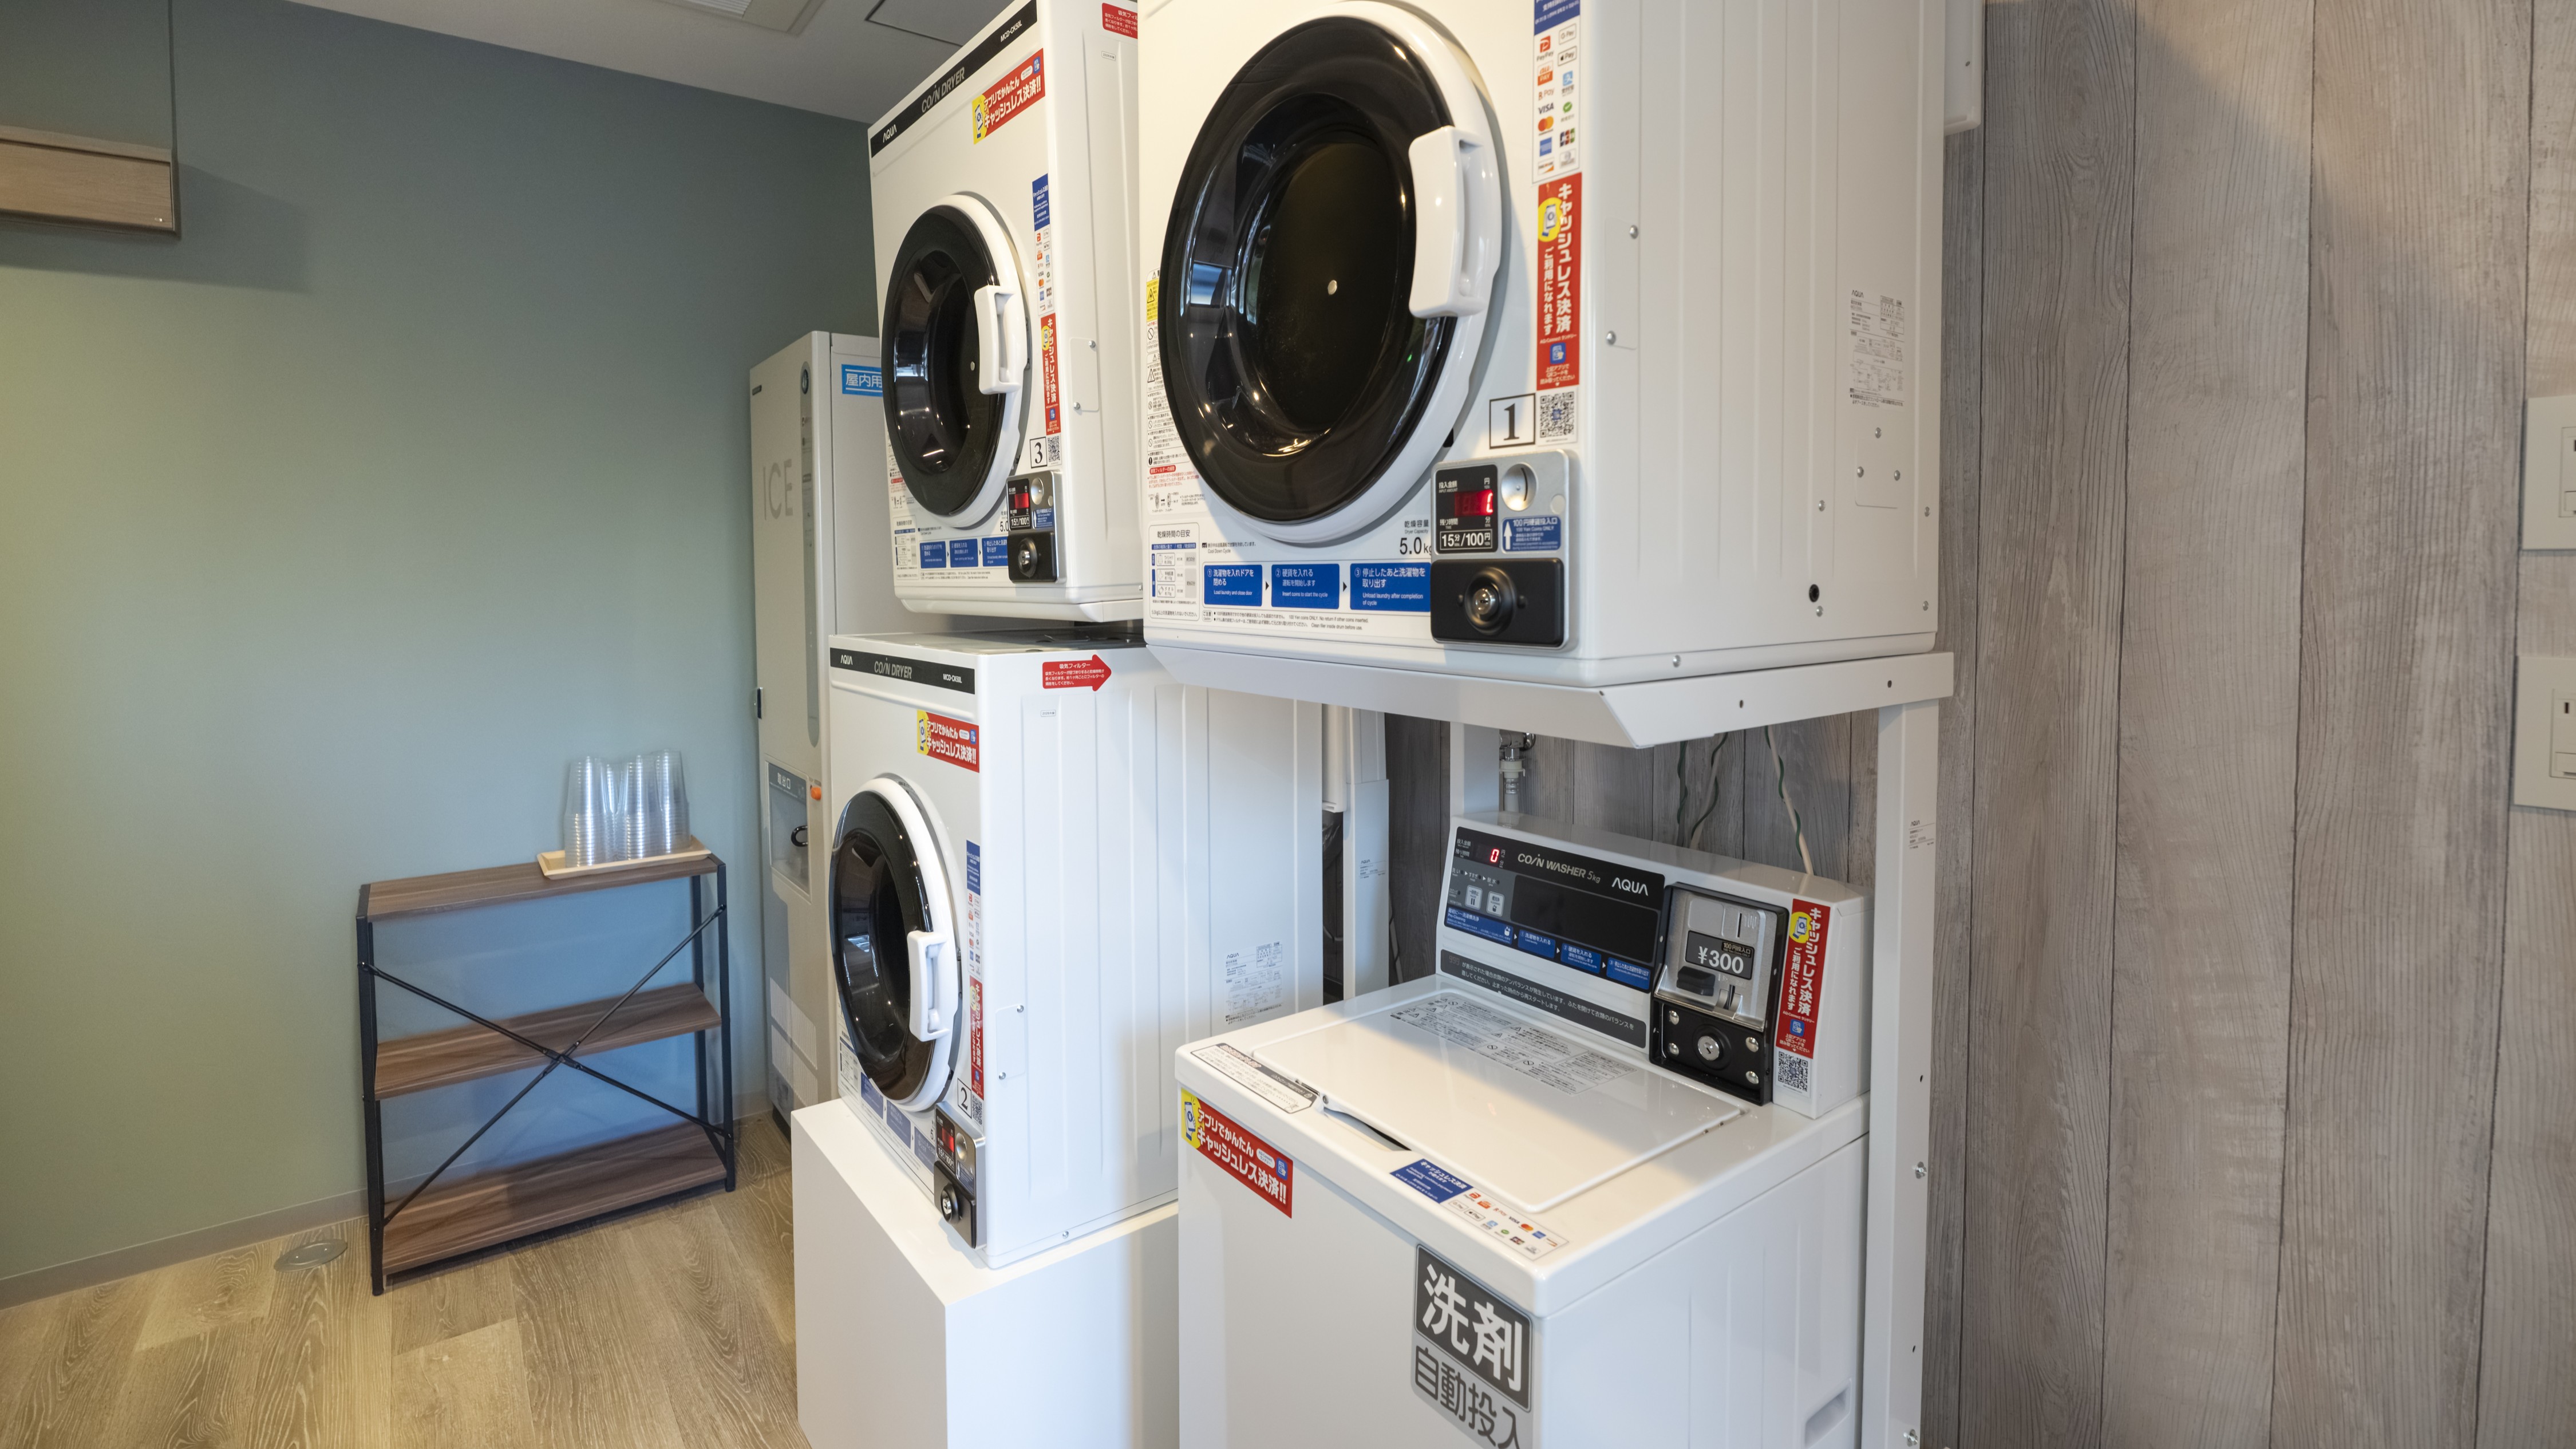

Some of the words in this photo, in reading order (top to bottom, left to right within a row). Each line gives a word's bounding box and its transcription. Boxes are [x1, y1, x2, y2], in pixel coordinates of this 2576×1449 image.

[1001, 19, 1022, 43] MCD-CK50L
[941, 66, 965, 97] DRYER
[984, 76, 1020, 112] アプリでかんたん
[1538, 102, 1554, 115] VISA
[883, 124, 897, 143] AQUA
[1556, 183, 1573, 333] キャッシュレス決済
[1543, 247, 1554, 335] ご利用になれます
[1851, 290, 1864, 298] AQUA
[846, 373, 883, 388] 屋内用
[1503, 403, 1520, 441] 1
[1034, 442, 1043, 464] 3
[762, 459, 793, 520] ICE
[1439, 480, 1457, 489] 投入金額
[1404, 519, 1429, 528] 乾燥容量
[1157, 530, 1190, 538] 乾燥時間の目安
[1400, 537, 1422, 555] 5.0
[1214, 568, 1254, 577] 洗濯物を入れドアを
[1282, 568, 1314, 577] 硬貨を入れる
[1362, 567, 1425, 577] 停止したあと洗濯物を
[1214, 578, 1227, 586] 閉める
[1362, 579, 1386, 588] 取り出す
[840, 655, 853, 666] AQUA
[891, 662, 912, 680] DRYER
[943, 673, 962, 684] MCD-CK50L
[927, 721, 958, 740] アプリでかんたん
[1457, 839, 1471, 847] 投入金額
[1455, 848, 1470, 857] 残り時間
[1490, 848, 1499, 863] 0
[1546, 861, 1586, 878] WASHER
[1586, 871, 1601, 884] 5kg
[1611, 877, 1649, 896] AQUA
[1525, 933, 1551, 945] 洗濯物を入れる
[1568, 946, 1593, 958] 硬貨を入れる
[1698, 946, 1744, 974] ¥300
[1797, 907, 1822, 1017] キャッシュレス決済
[1787, 947, 1803, 1011] ご利用になれます
[961, 1087, 968, 1111] 2
[1198, 1108, 1254, 1158] アプリでかんたん
[1197, 1127, 1287, 1205] キャッシュレス決済!!
[1509, 1216, 1520, 1224] VISA
[1422, 1264, 1523, 1392] 洗剤
[1415, 1345, 1520, 1449] 自動投入
